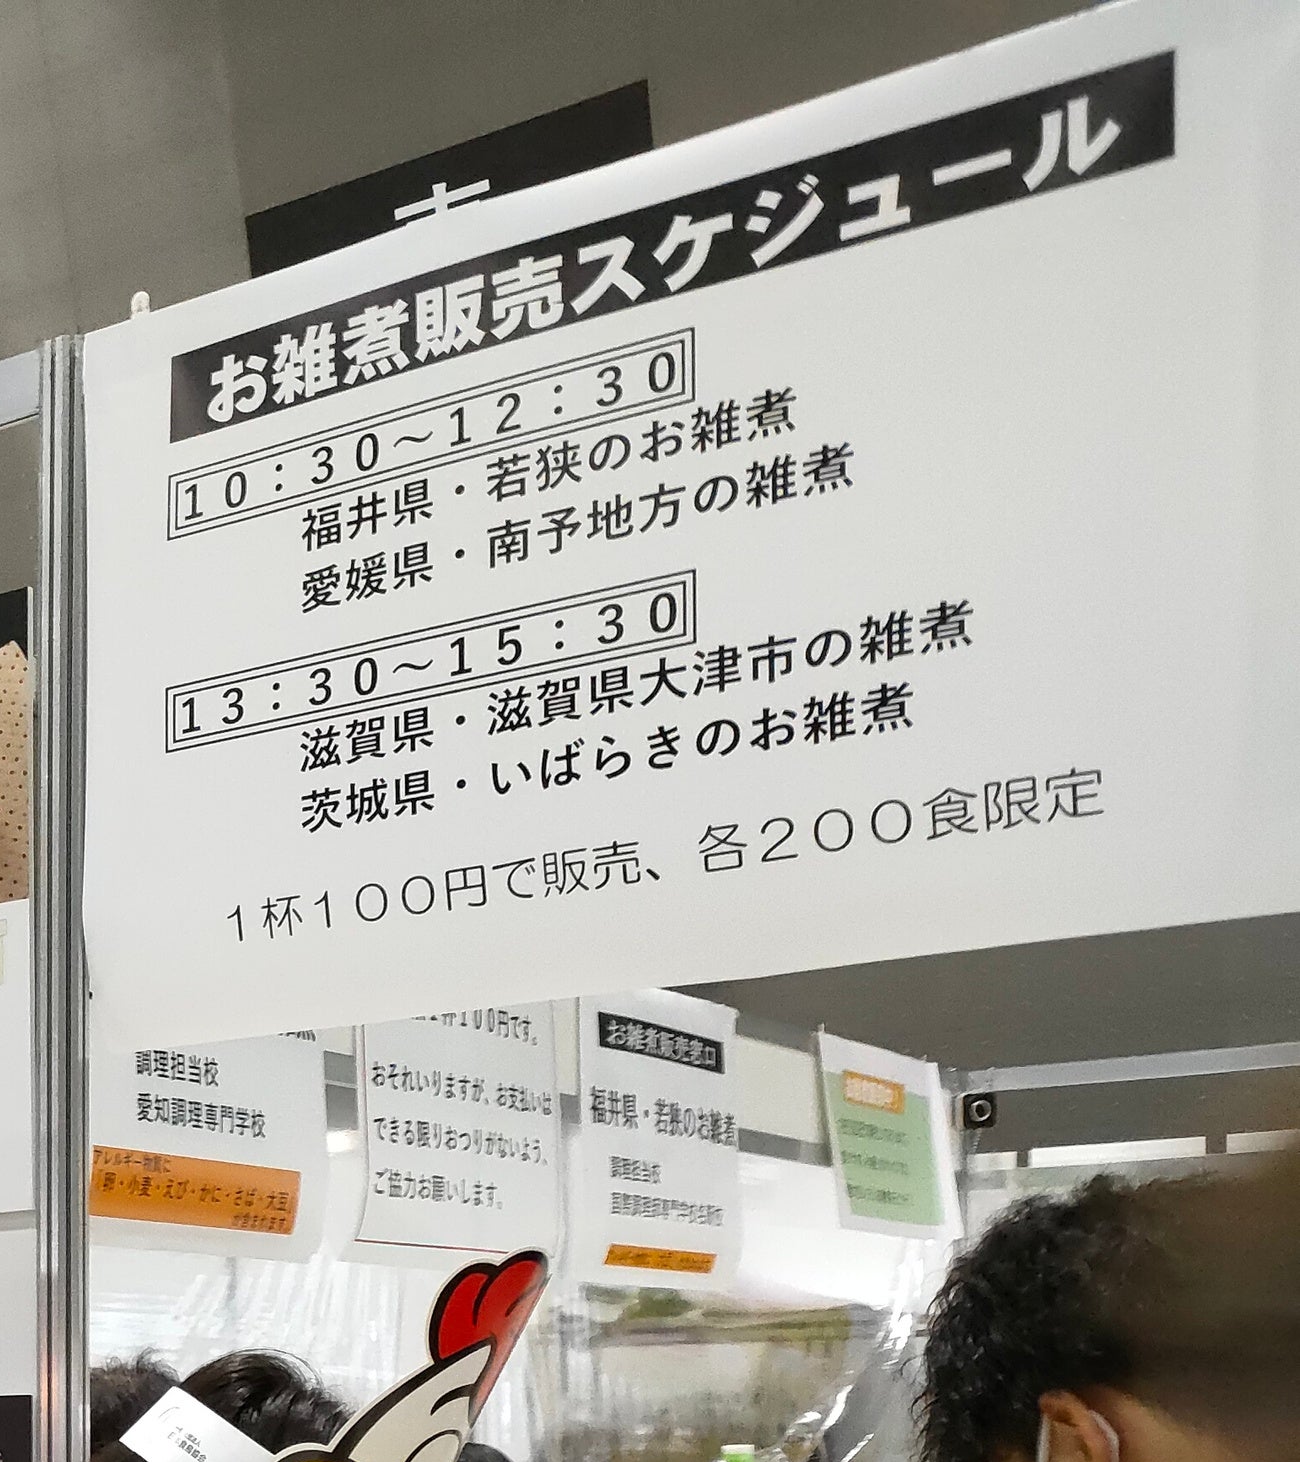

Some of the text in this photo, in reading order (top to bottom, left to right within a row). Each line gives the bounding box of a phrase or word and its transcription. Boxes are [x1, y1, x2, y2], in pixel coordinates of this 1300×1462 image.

[206, 97, 1122, 424] お雑煮販売スケジュール
[301, 388, 798, 552] 福井県・若狭のお雑煮
[301, 442, 857, 614] 愛媛県・南予地方の雑煮
[299, 598, 976, 773] 滋賀県・滋賀県大津市の雑煮
[299, 681, 915, 834] 茨城県・いばらきのお雑煮
[135, 1050, 219, 1087] 調理担当校
[137, 1093, 266, 1138] 愛知調理専門学校
[371, 1061, 552, 1115] おそれいりますが、お支払いは
[374, 1117, 548, 1166] できる限りおつりがないよう、
[374, 1168, 503, 1210] ご協力お願いします。
